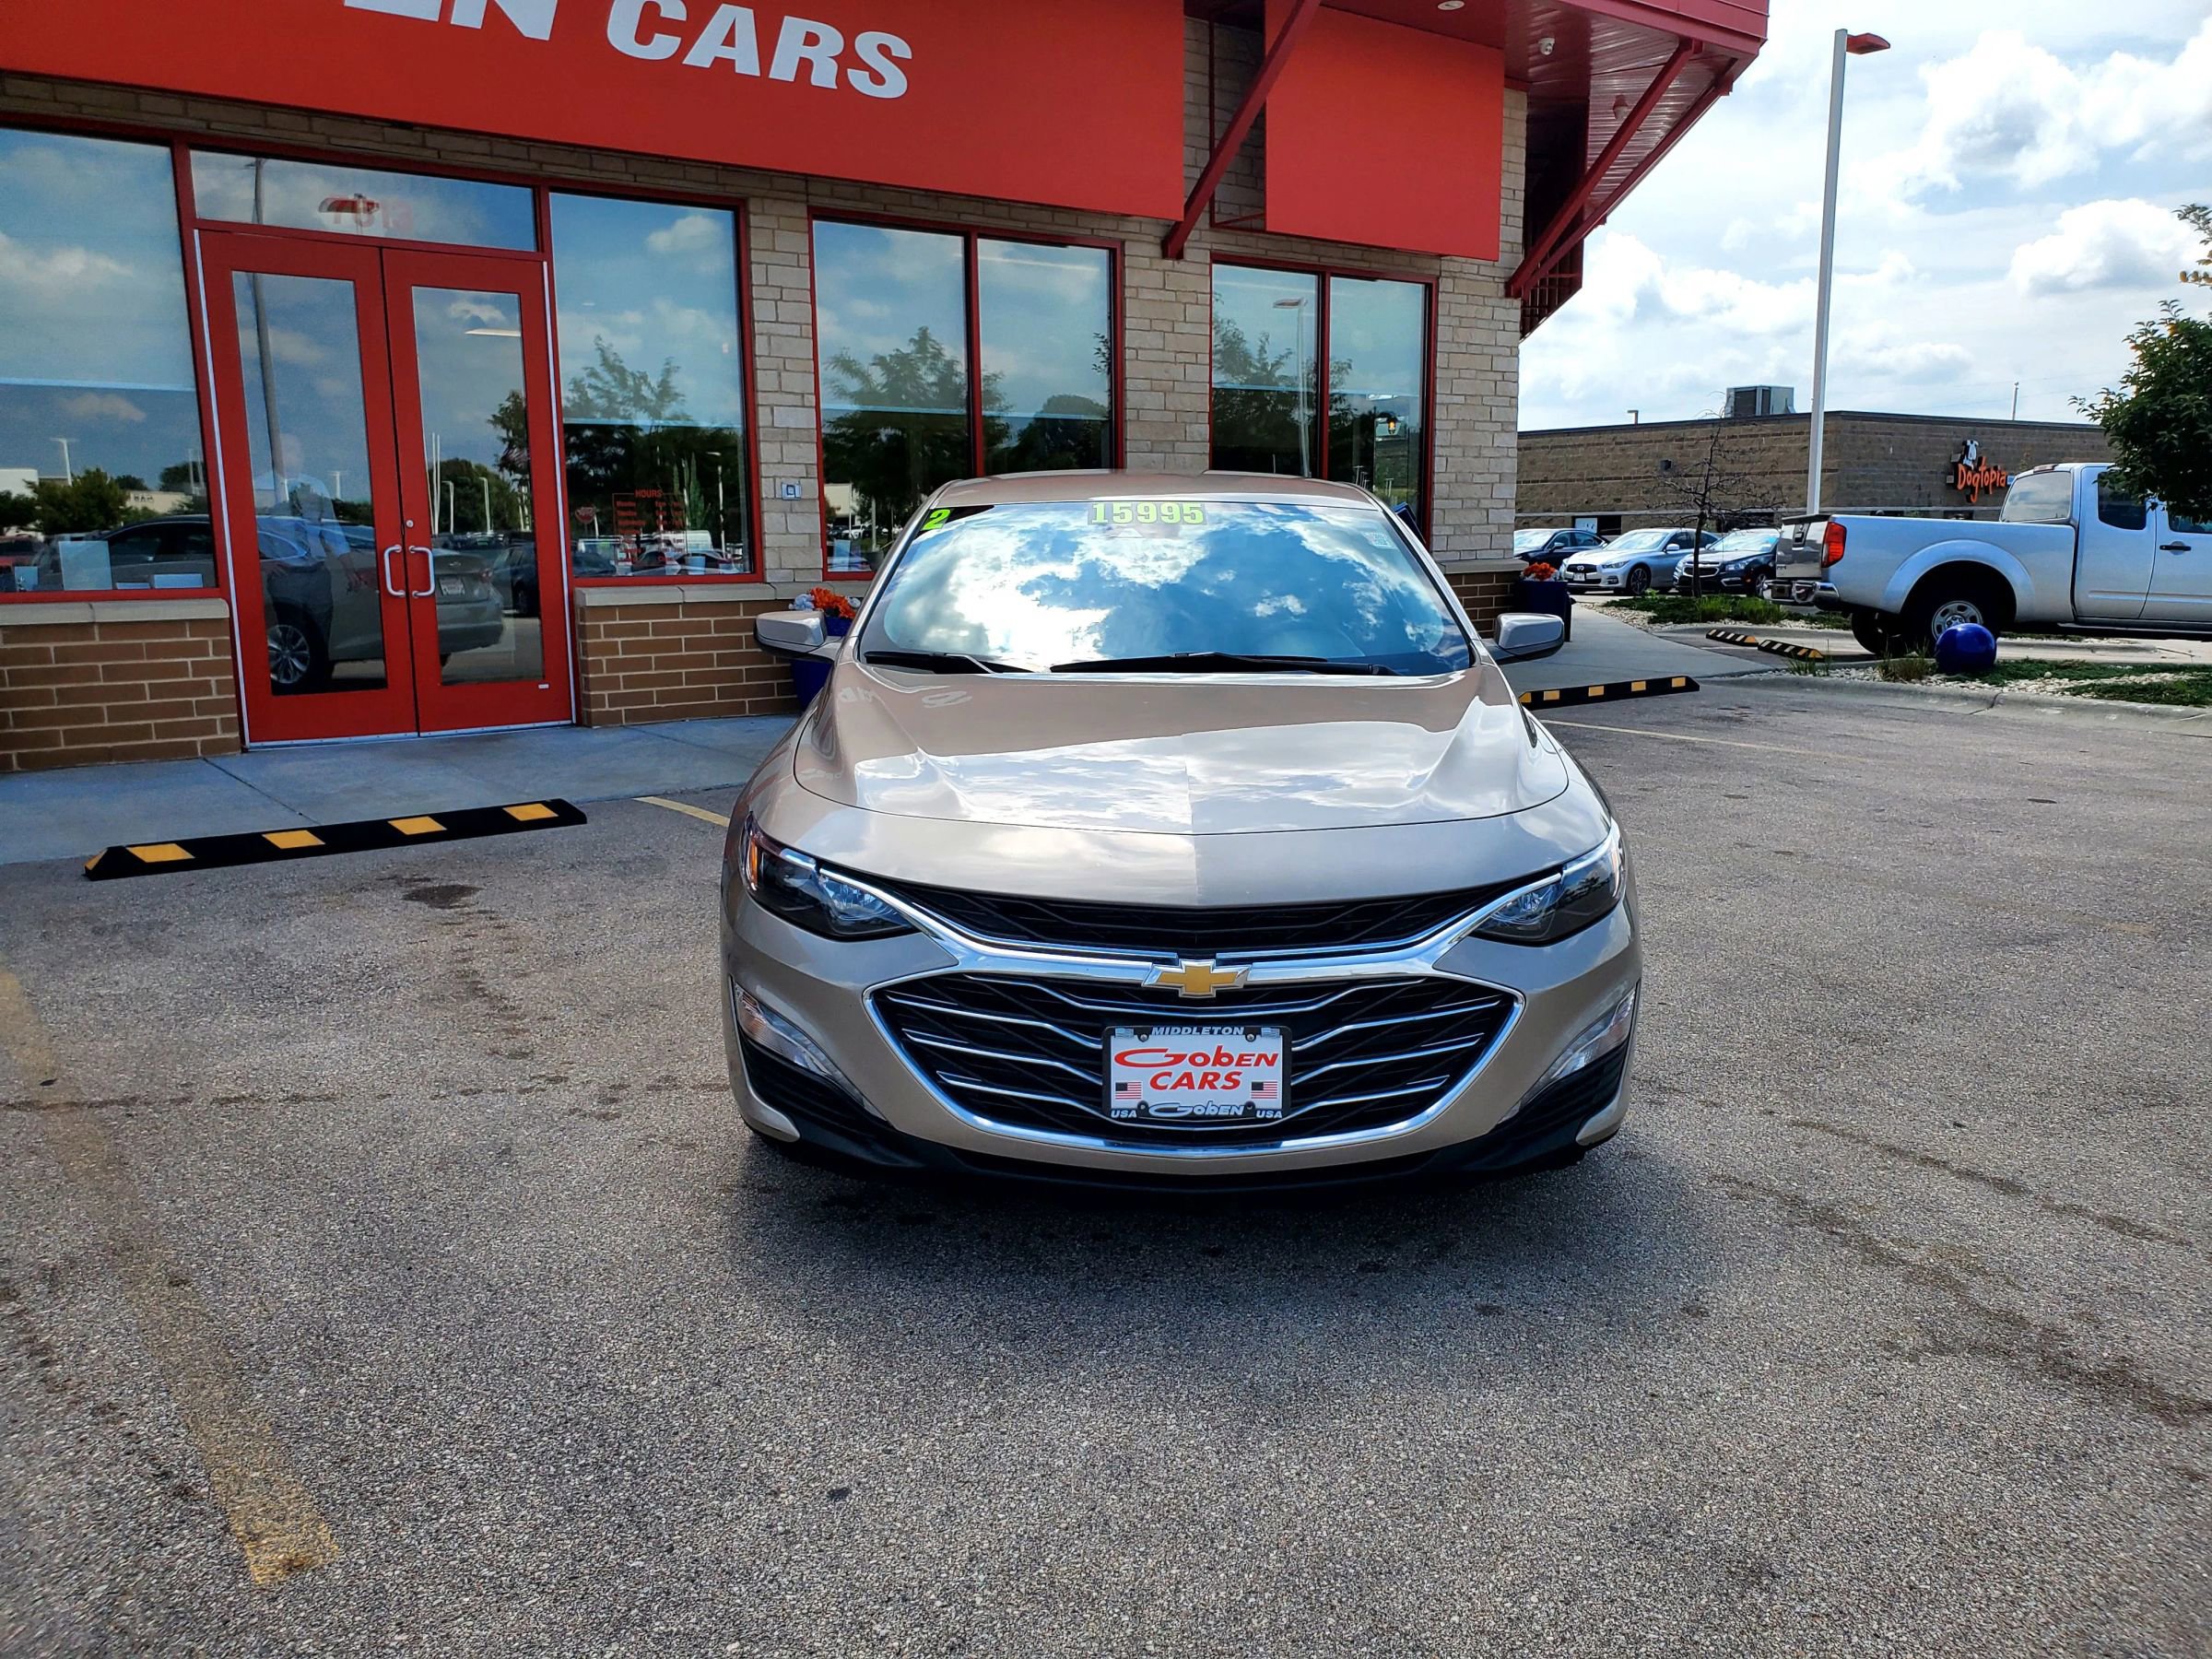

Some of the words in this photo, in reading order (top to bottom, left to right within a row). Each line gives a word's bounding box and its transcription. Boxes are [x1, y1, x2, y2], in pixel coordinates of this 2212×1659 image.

[606, 0, 913, 100] CARS
[1957, 455, 2008, 504] Dogtopia
[634, 488, 664, 499] HOURS
[923, 509, 951, 530] 2
[1091, 501, 1206, 525] 15995
[1151, 1026, 1245, 1036] MIDDLETON
[1149, 1071, 1242, 1090] CARS
[1111, 1109, 1137, 1118] USA
[1255, 1110, 1283, 1119] USA
